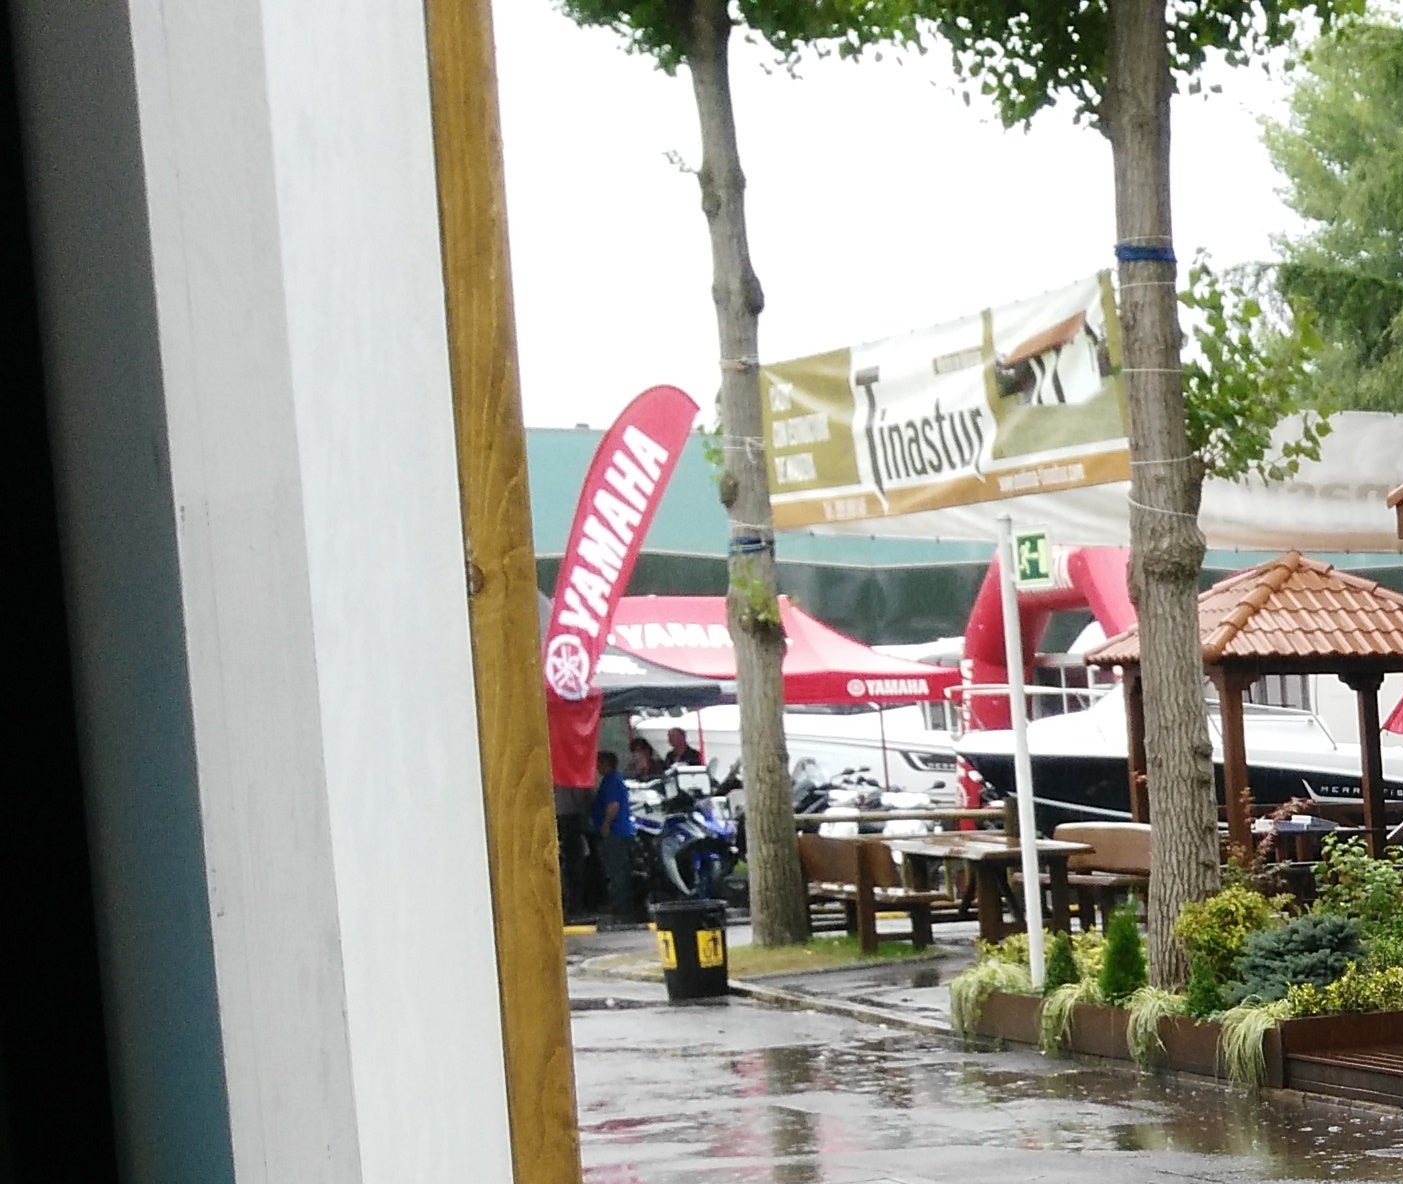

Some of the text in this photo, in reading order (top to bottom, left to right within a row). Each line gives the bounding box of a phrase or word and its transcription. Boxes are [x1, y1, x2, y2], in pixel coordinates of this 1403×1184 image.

[558, 424, 670, 638] YAMAHA
[615, 622, 734, 649] YAMA
[865, 679, 929, 696] YAMAHA
